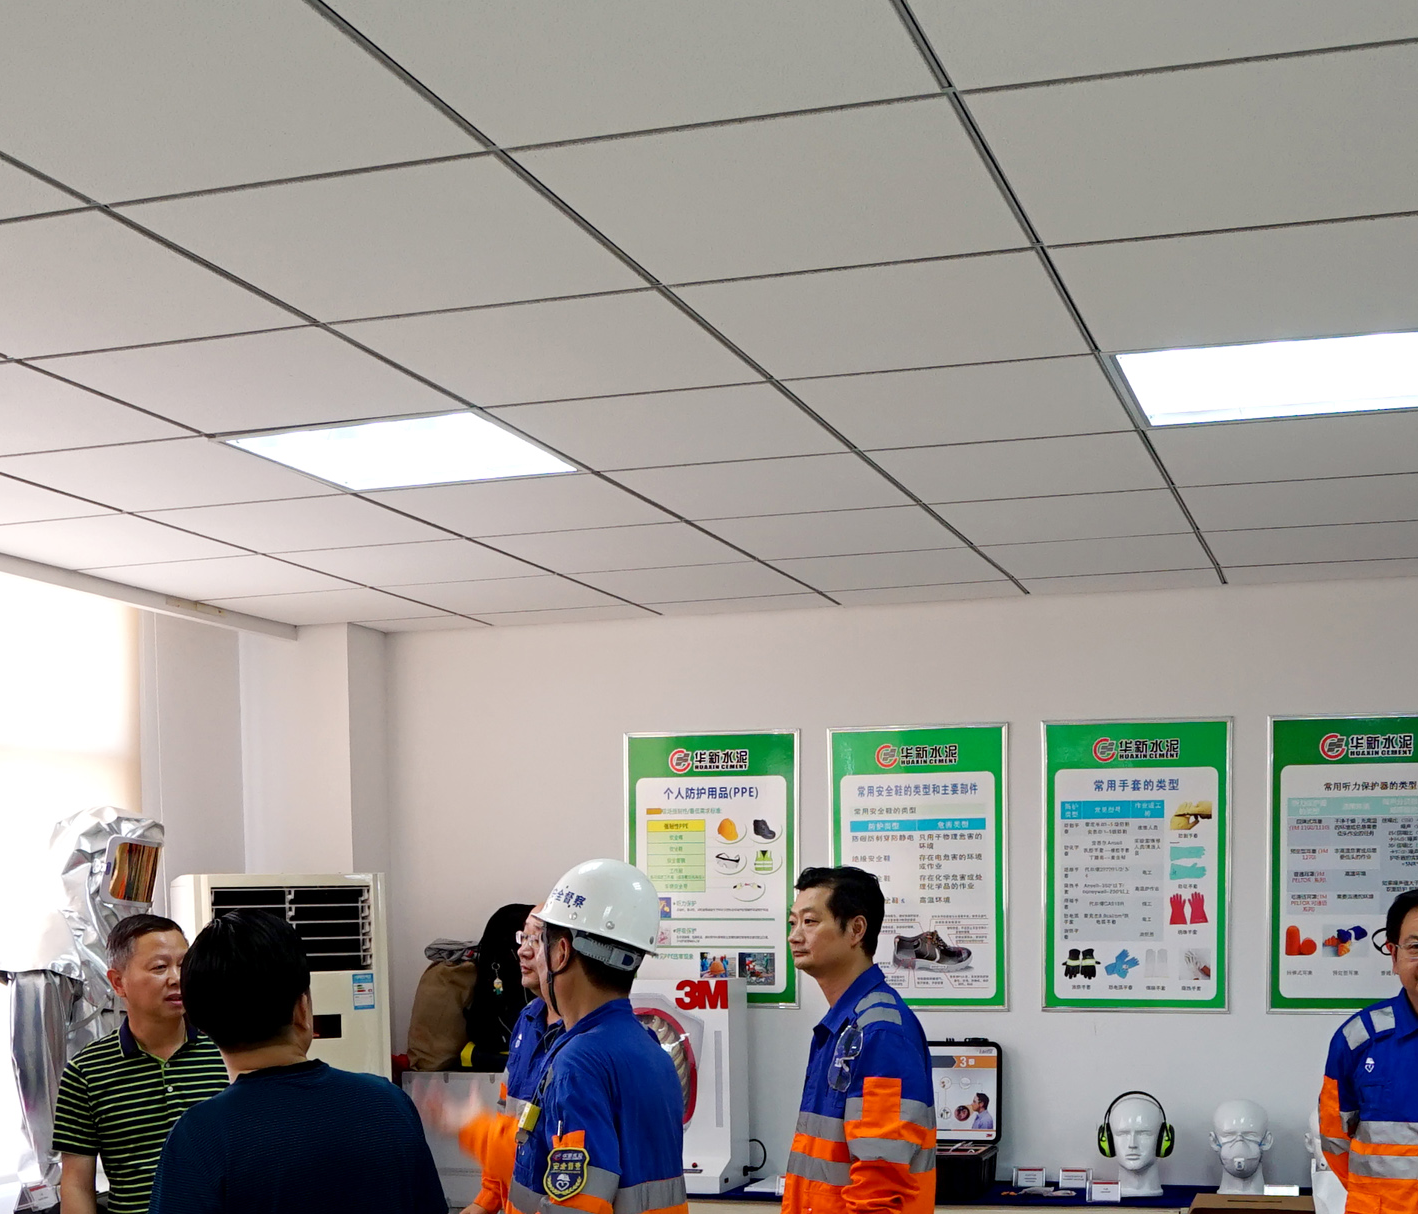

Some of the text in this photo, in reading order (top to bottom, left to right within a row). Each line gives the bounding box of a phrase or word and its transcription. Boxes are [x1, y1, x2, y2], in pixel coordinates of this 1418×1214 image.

[1119, 740, 1179, 753] 华新水泥
[1350, 735, 1412, 749] 华新水泥
[694, 751, 748, 764] 华新水泥
[900, 744, 958, 758] 华新水泥
[857, 782, 978, 797] 常用安全鞋的类型和主要部件
[1093, 778, 1180, 792] 常用手套的类型
[1323, 781, 1417, 791] 常用听力保护器的类型
[663, 786, 759, 800] 个人防护用品(PPE)
[854, 807, 917, 815] 常用安全鞋的类型
[919, 833, 982, 841] 只用于物理危害的
[919, 853, 983, 861] 存在电危害的环境
[675, 979, 729, 1011] 3M
[959, 1056, 967, 1068] 3
